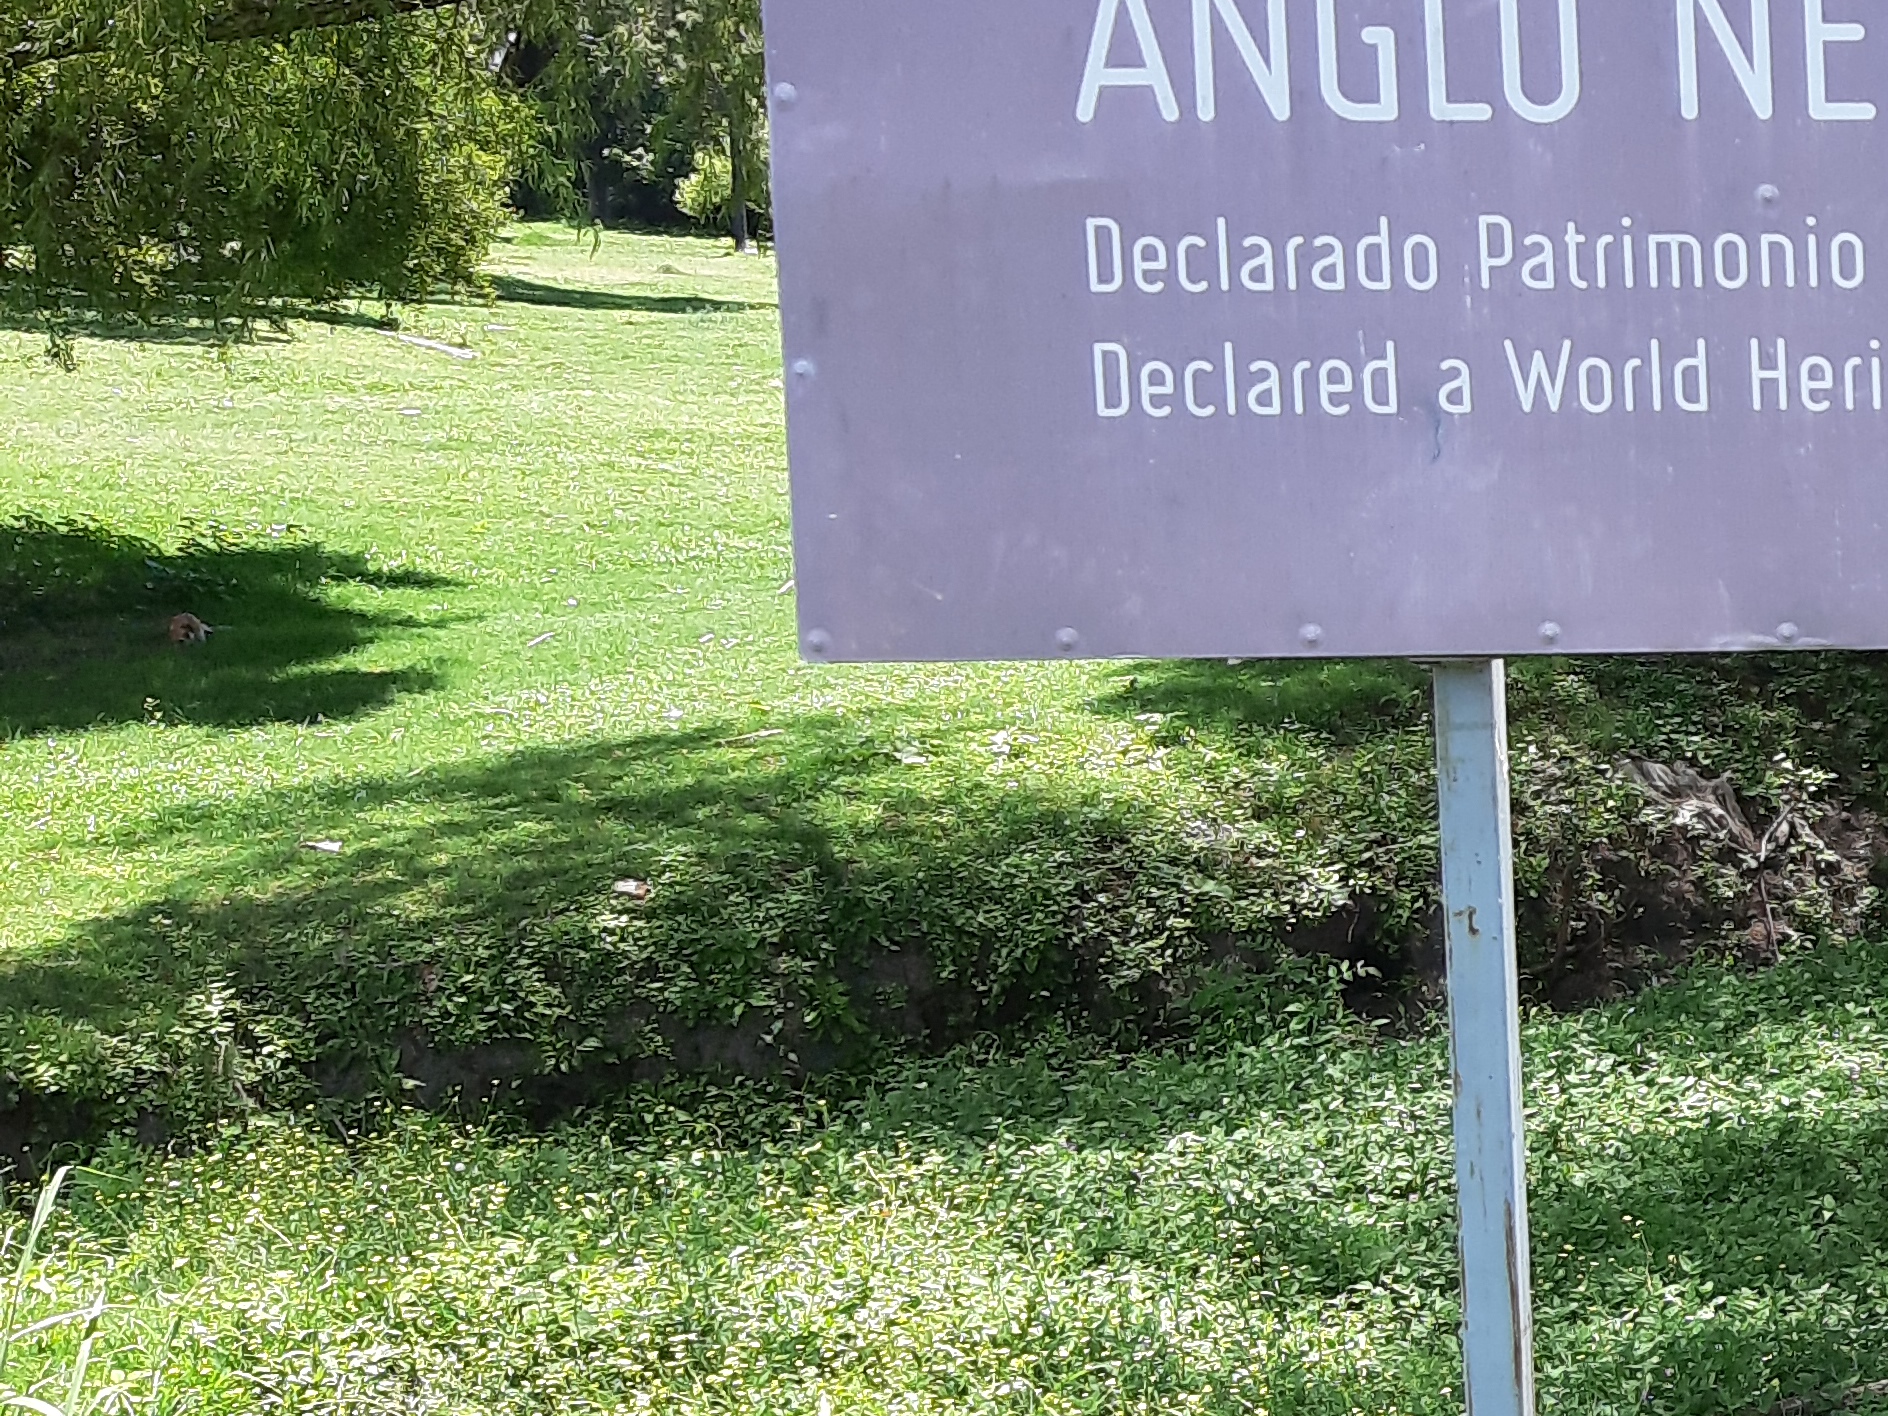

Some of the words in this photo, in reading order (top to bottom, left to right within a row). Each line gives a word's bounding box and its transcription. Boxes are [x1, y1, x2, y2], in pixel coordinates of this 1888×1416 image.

[1085, 214, 1440, 295] Declarado
[1476, 215, 1866, 290] Patrimonio
[1092, 339, 1399, 418] Declared
[1438, 358, 1474, 415] a
[1502, 337, 1711, 415] World
